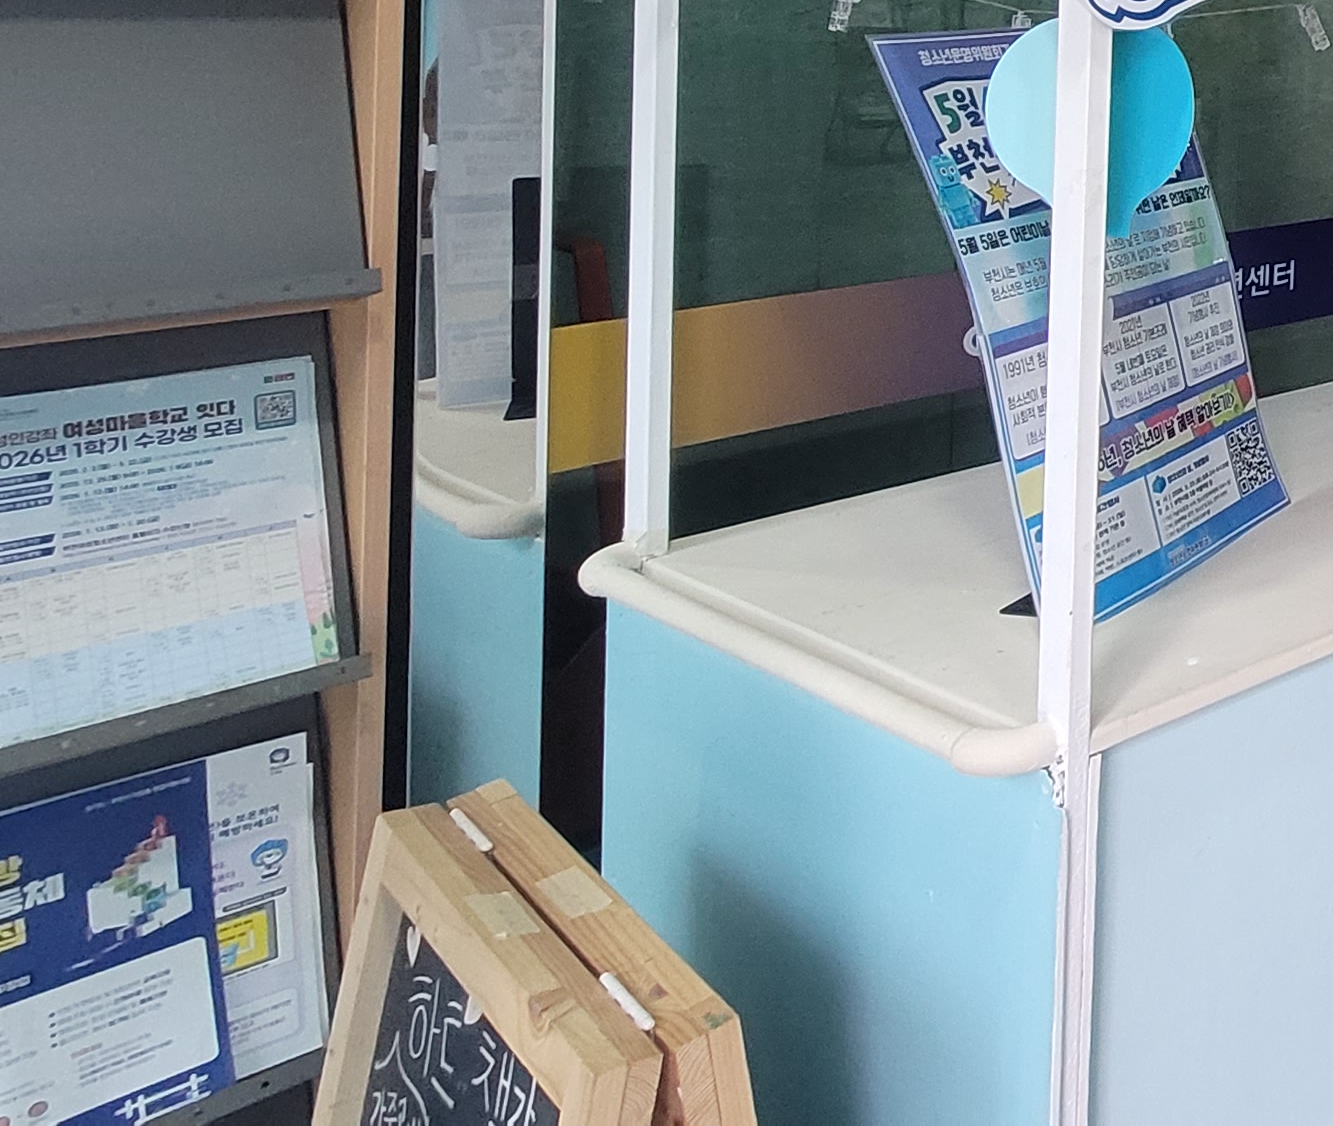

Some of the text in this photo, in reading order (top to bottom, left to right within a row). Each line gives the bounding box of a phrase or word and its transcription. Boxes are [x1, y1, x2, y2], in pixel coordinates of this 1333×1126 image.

[934, 87, 985, 133] 5월
[958, 236, 980, 256] 5월
[979, 229, 1011, 250] 5일은
[983, 265, 1017, 283] 부천시는
[1033, 257, 1047, 271] 5월
[991, 282, 1025, 302] 청소년은
[1003, 350, 1048, 379] 1991년 청
[1007, 388, 1039, 411] 청소년이
[62, 406, 188, 439] 여성마을학교
[195, 399, 237, 421] 잇다
[72, 434, 128, 458] 1학기
[133, 426, 198, 449] 수강생
[203, 418, 244, 439] 모집
[1121, 420, 1164, 461] 청소년의
[1165, 416, 1176, 440] 날
